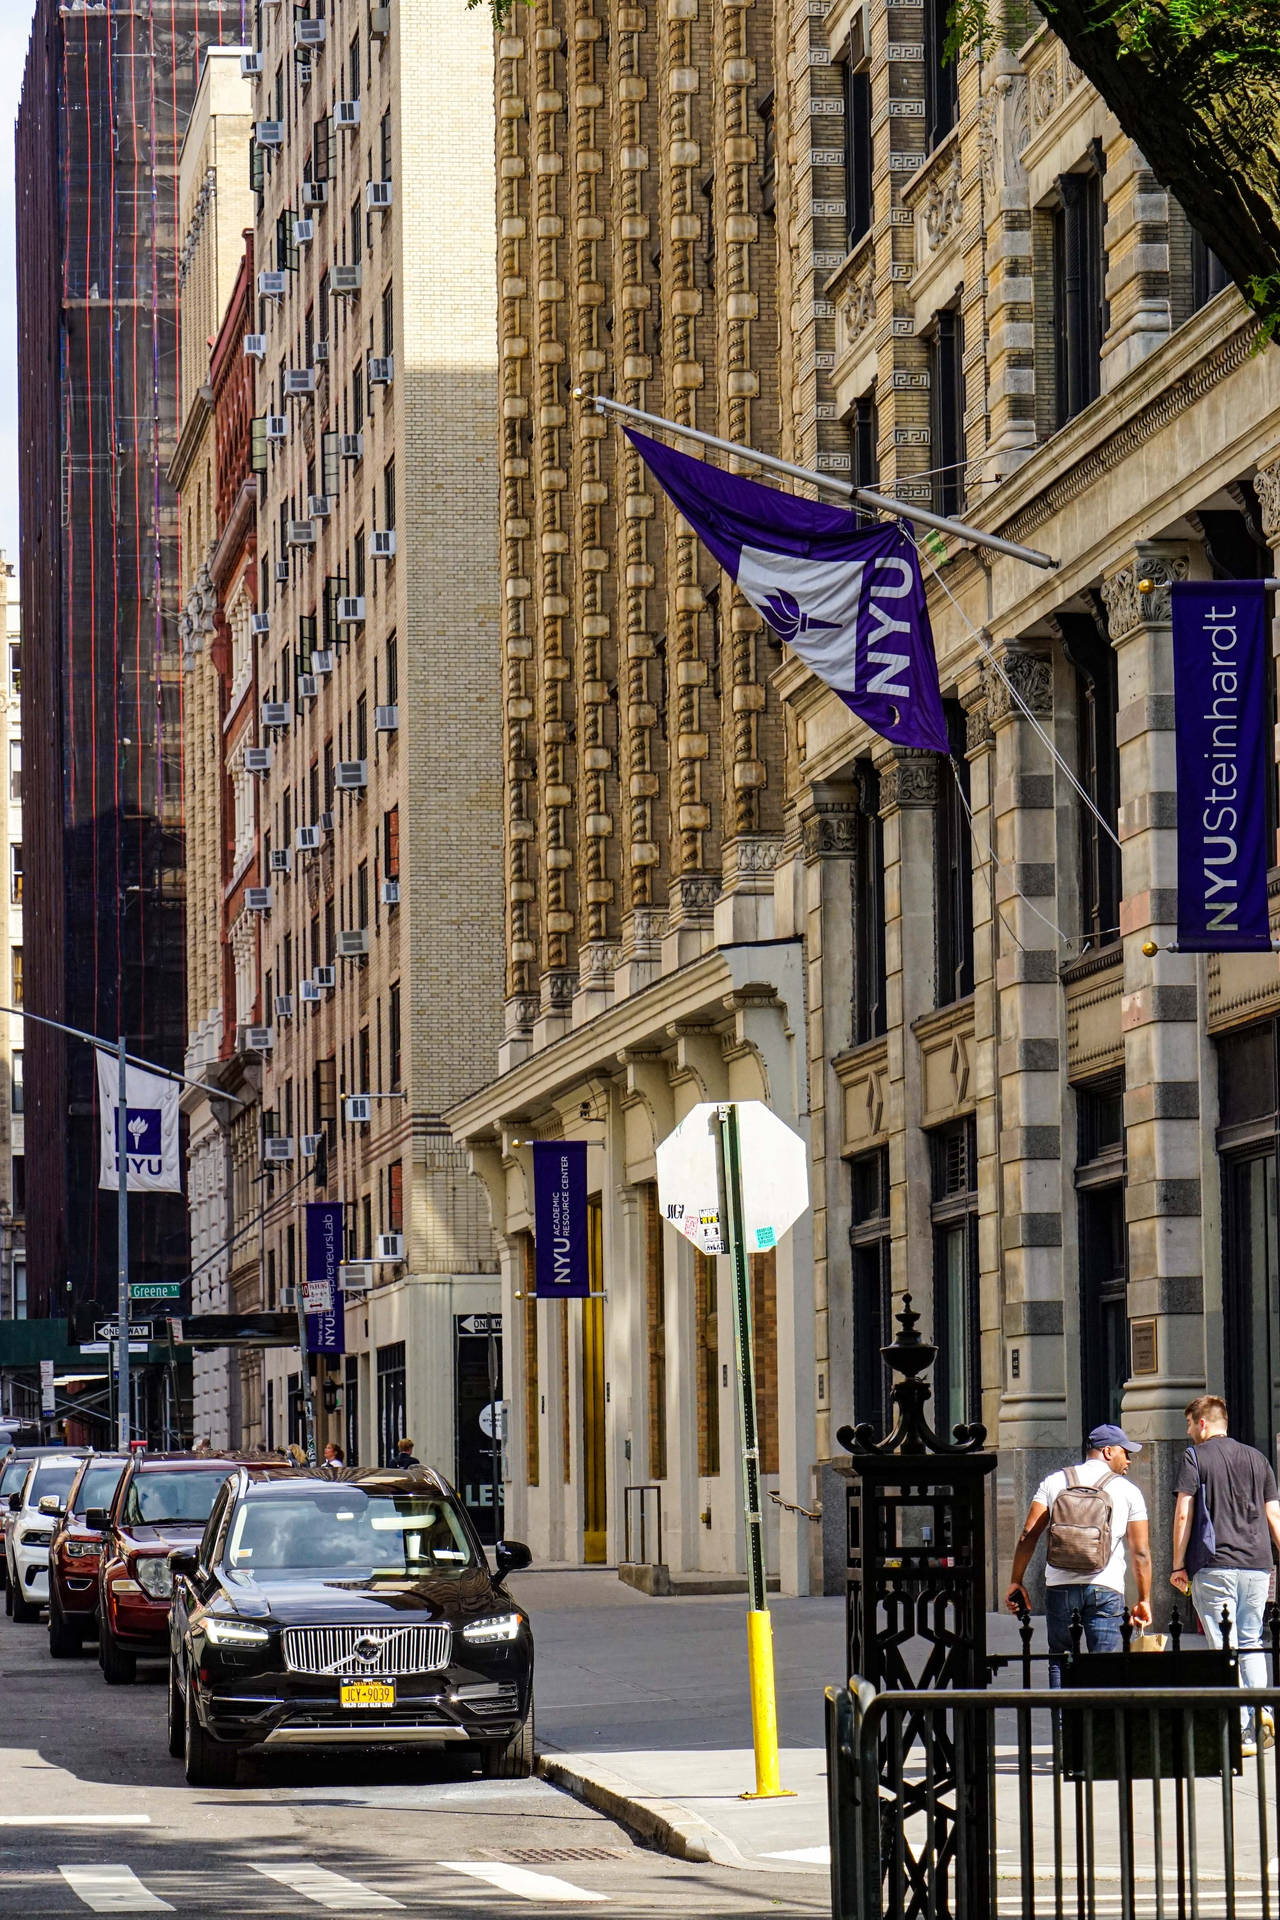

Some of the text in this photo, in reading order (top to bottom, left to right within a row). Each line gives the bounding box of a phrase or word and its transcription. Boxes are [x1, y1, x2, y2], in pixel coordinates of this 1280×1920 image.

[866, 556, 914, 698] NYU
[1202, 605, 1239, 932] NYUSteinhardt
[552, 1191, 561, 1236] ACADEMIC
[560, 1156, 570, 1237] RESOURCE CENTER
[133, 1286, 168, 1297] Greene
[553, 1238, 571, 1283] NYU
